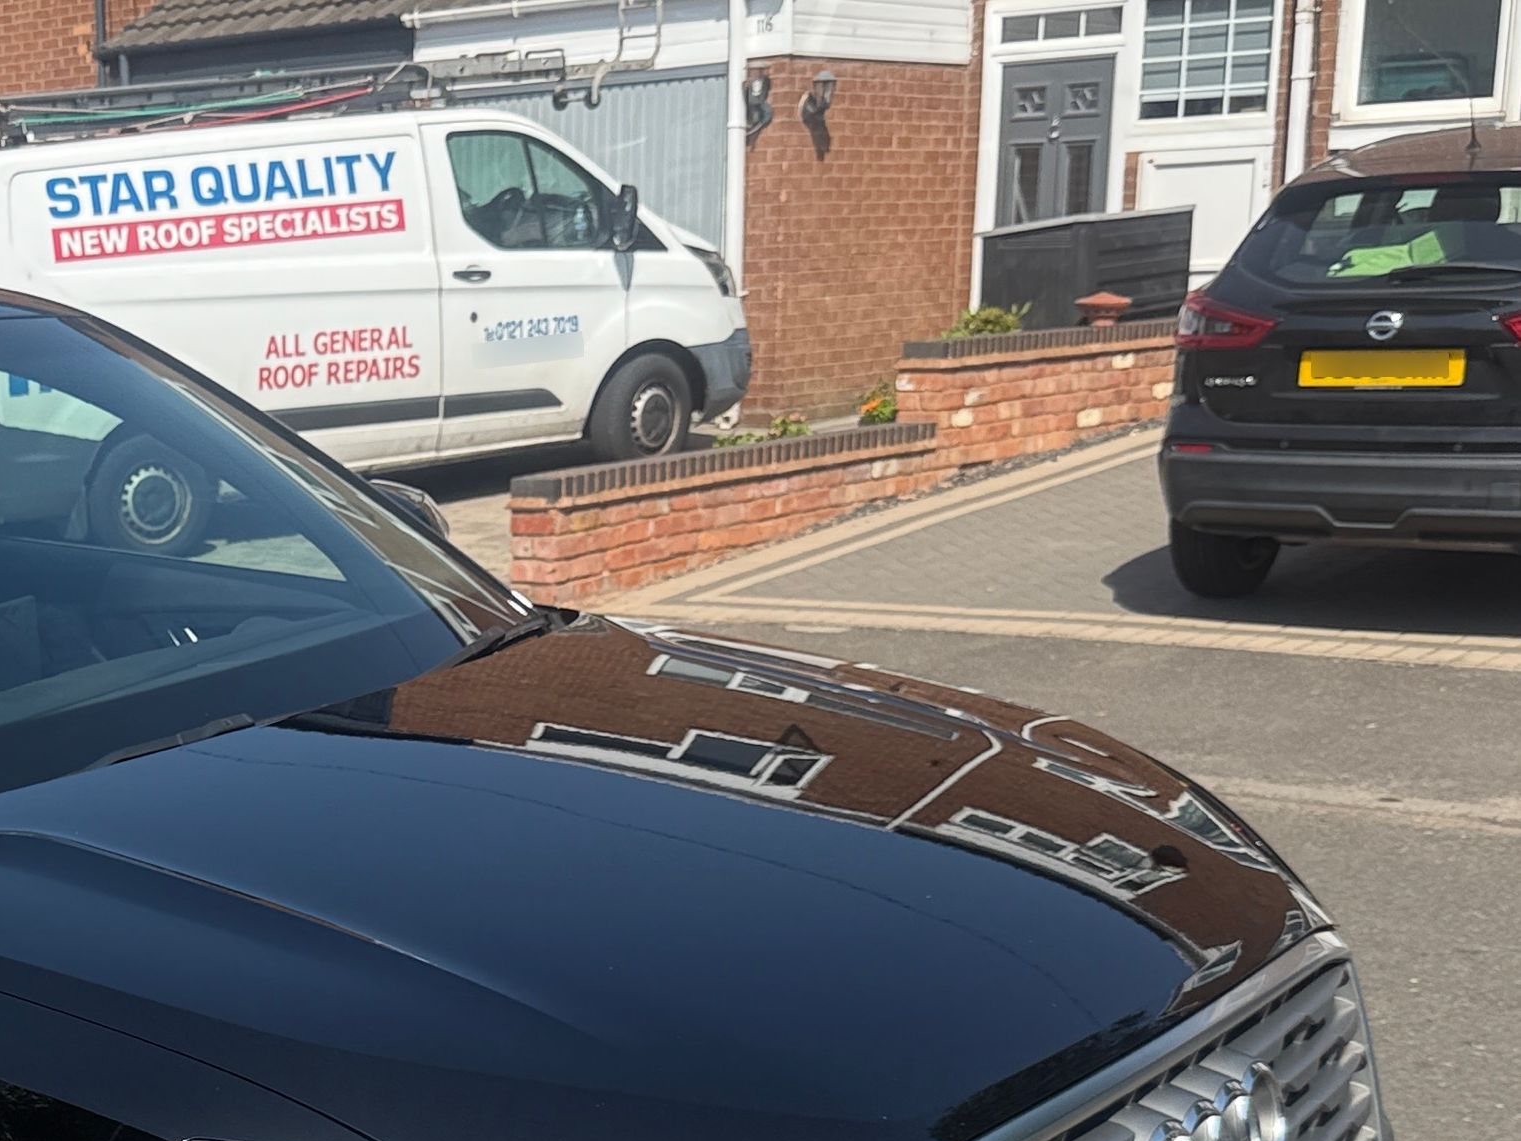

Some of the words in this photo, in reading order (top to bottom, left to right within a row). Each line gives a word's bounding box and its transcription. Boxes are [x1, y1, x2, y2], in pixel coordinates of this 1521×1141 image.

[45, 169, 179, 219] STAR
[190, 151, 397, 207] QUALITY
[59, 227, 129, 258] NEW
[137, 219, 216, 250] ROOF
[222, 204, 400, 243] SPECIALISTS
[265, 333, 306, 360] ALL
[313, 325, 413, 356] GENERAL
[258, 363, 319, 391] ROOF
[326, 354, 421, 386] REPAIRS
